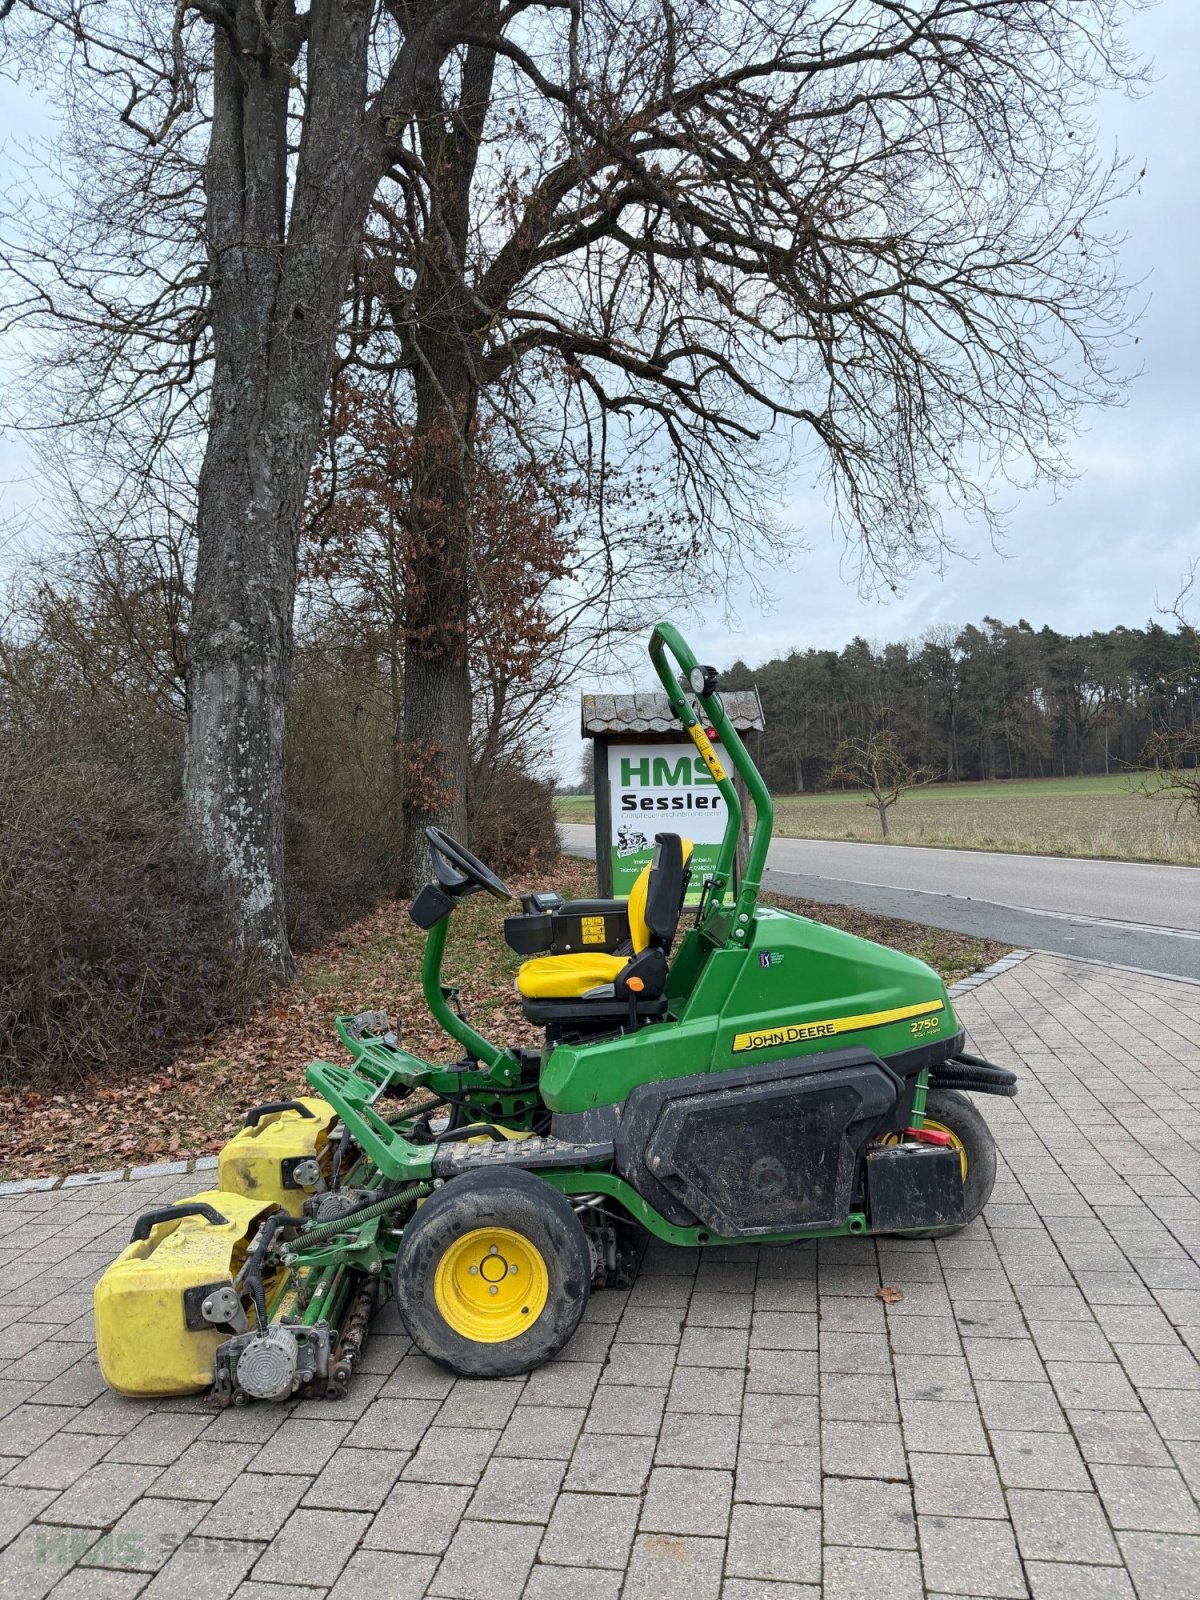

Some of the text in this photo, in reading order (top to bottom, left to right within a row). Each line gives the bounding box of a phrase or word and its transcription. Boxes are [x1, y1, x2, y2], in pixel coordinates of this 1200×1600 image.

[621, 757, 719, 787] HMS
[621, 793, 721, 811] Sessler
[910, 1017, 939, 1033] 2750
[745, 1023, 836, 1050] JOHN DEERE
